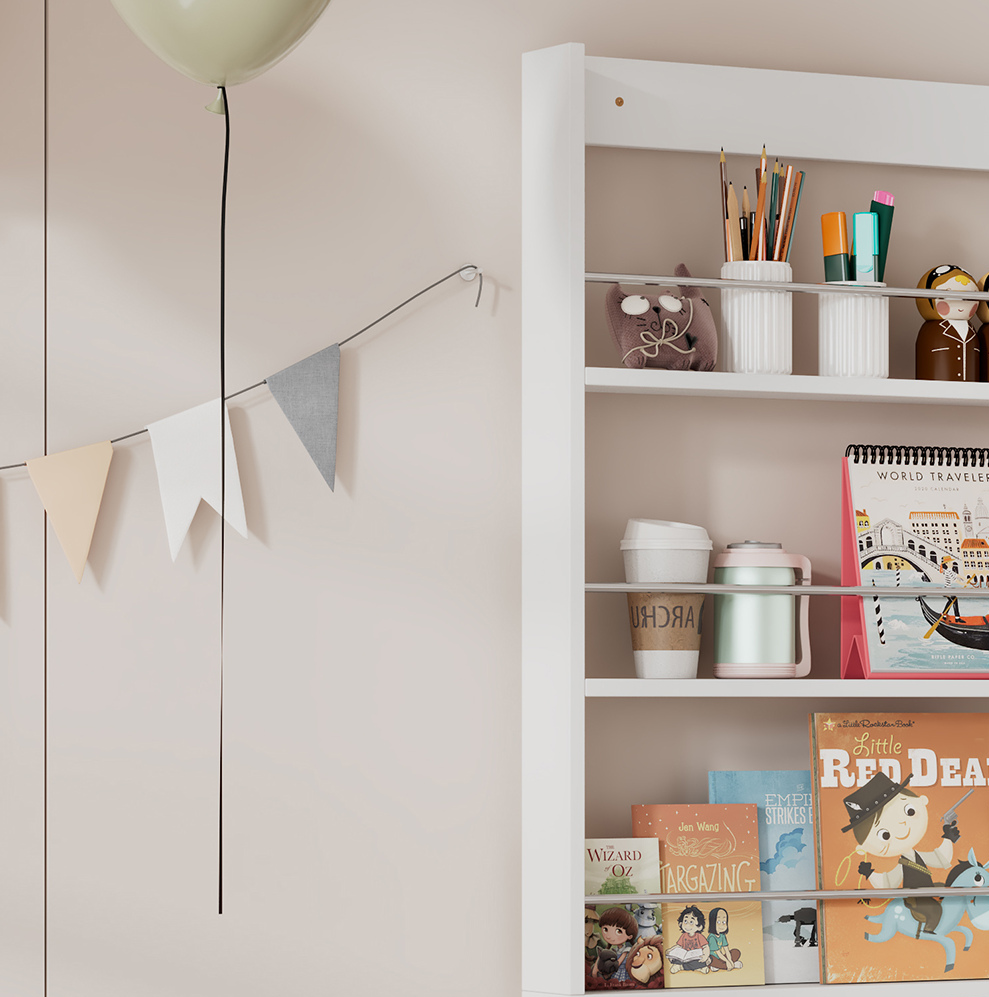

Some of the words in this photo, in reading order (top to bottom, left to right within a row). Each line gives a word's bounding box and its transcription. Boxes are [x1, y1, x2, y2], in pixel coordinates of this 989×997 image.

[877, 471, 923, 481] WORLD
[853, 732, 902, 757] Little
[819, 749, 902, 788] RED
[765, 806, 805, 825] STRIKES
[678, 822, 694, 832] Jen
[696, 821, 719, 832] Wang
[587, 848, 642, 862] WIZARD
[612, 863, 634, 878] OZ
[660, 860, 756, 893] TARGAZING
